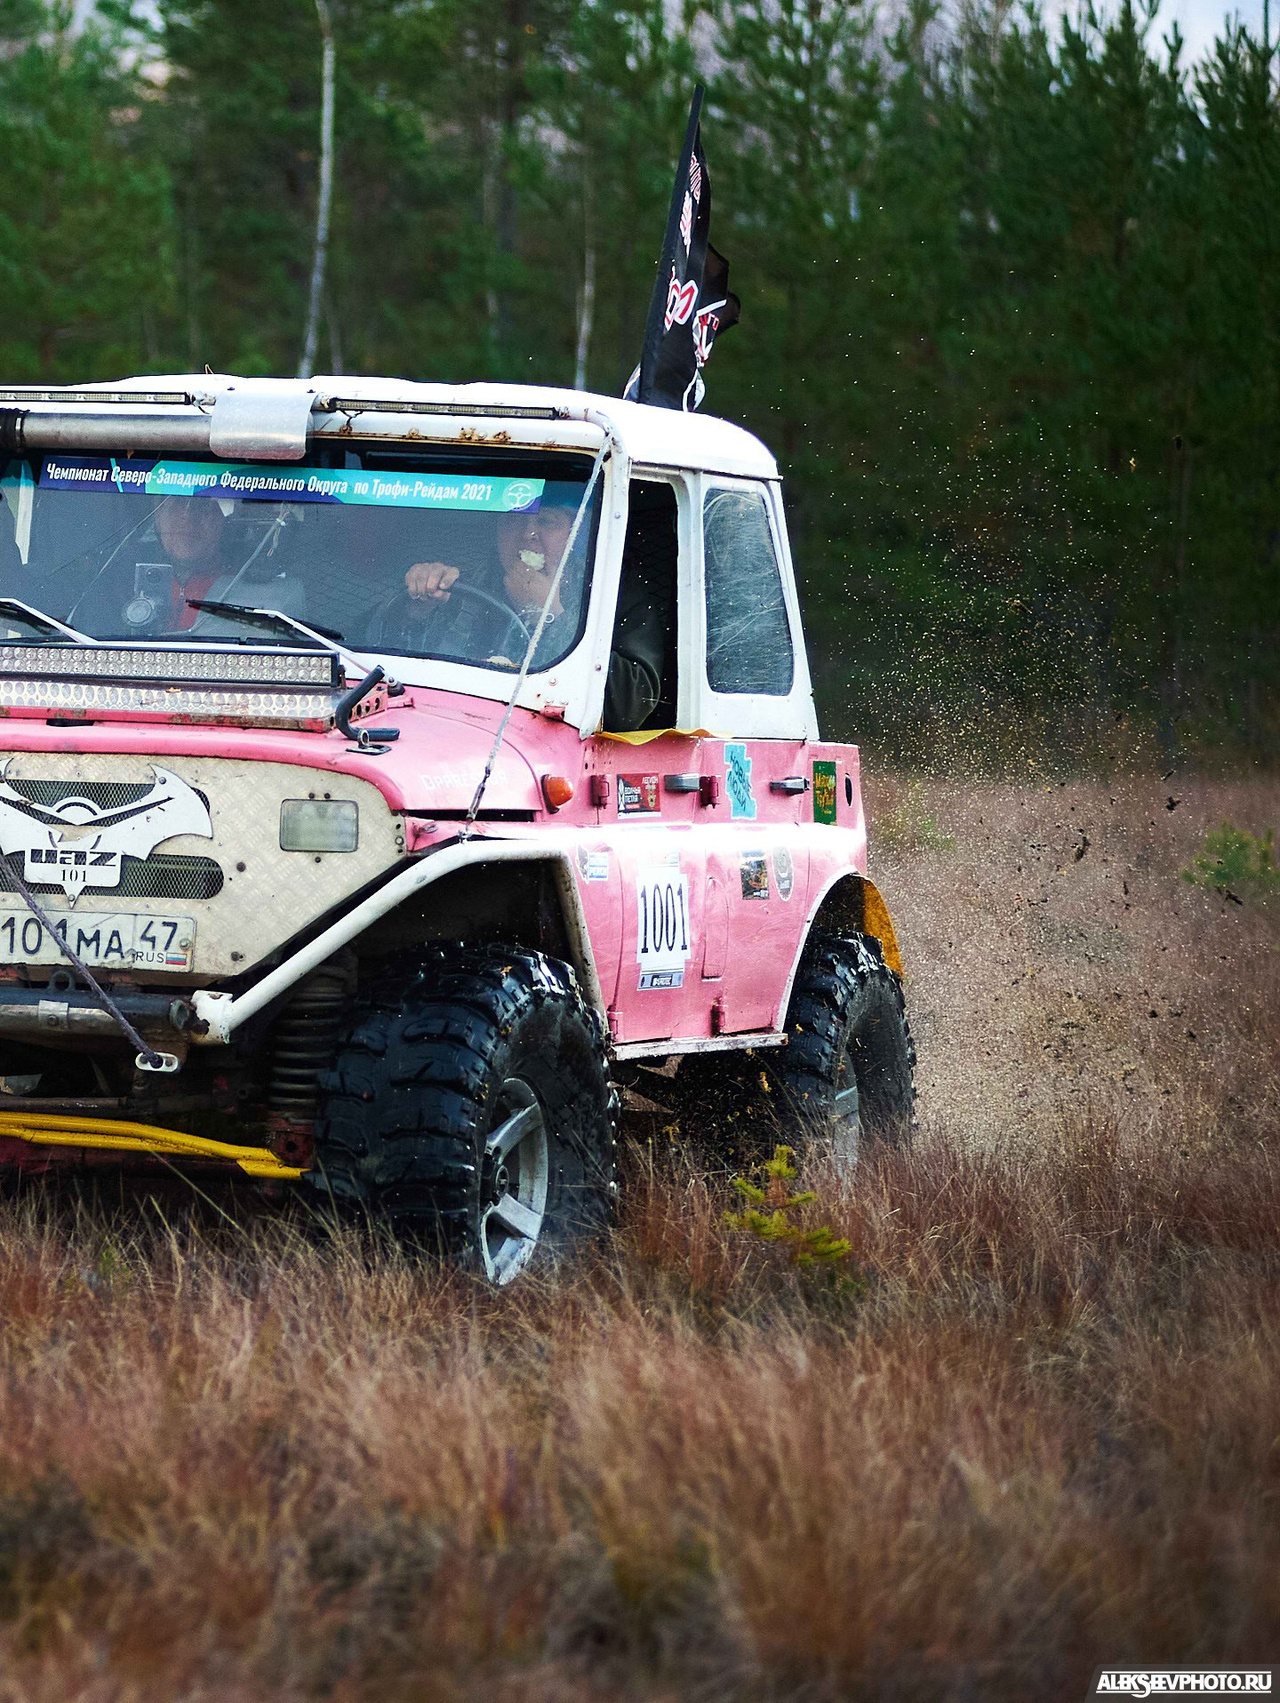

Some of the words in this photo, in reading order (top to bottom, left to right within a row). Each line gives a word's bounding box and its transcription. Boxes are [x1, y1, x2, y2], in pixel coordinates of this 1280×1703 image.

[46, 463, 109, 483] Чемпионат
[111, 465, 217, 488] Северо-Западного
[220, 471, 305, 493] Федерального
[307, 475, 348, 496] Округа
[354, 482, 369, 497] по
[372, 478, 459, 502] Трофи-Рейдам
[461, 483, 491, 502] 2021
[61, 869, 87, 883] 101
[640, 883, 688, 954] 1001
[140, 920, 178, 951] 47
[135, 951, 165, 963] RUS
